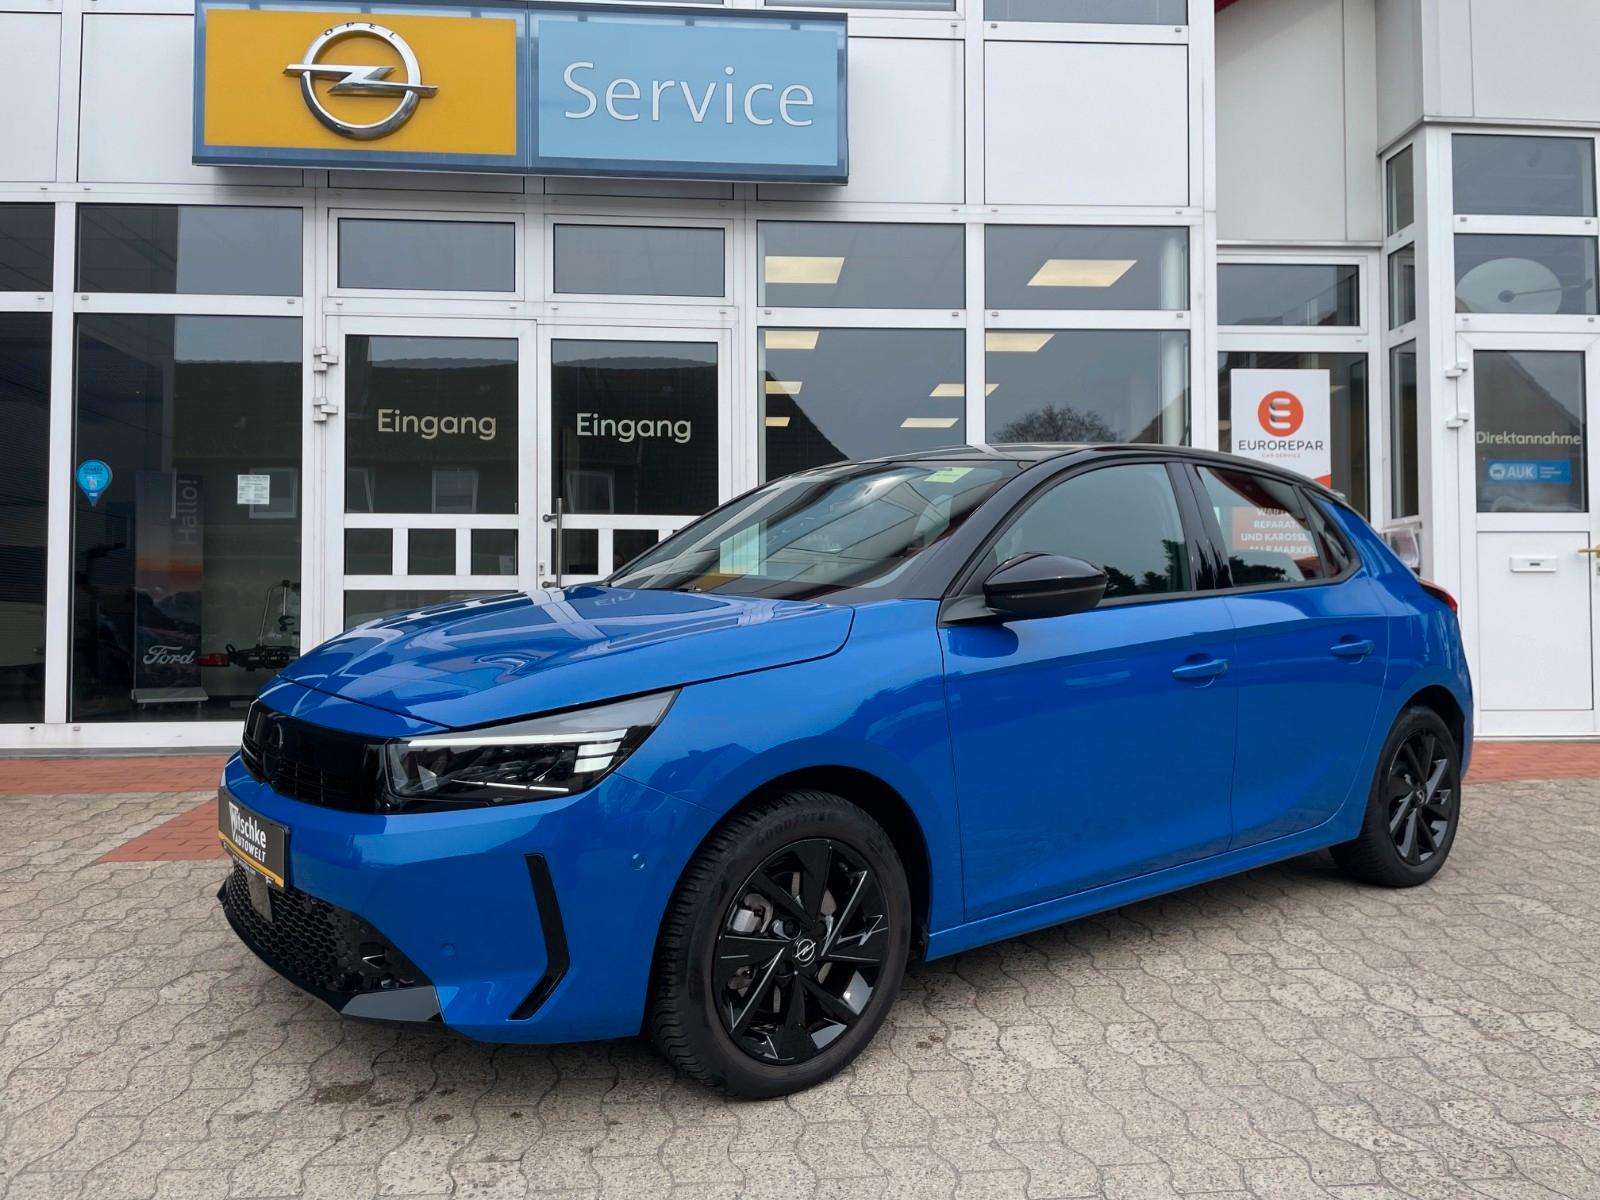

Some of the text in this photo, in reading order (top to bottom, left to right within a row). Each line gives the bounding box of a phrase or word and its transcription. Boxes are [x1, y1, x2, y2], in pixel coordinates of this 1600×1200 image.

[323, 21, 396, 39] OPEL
[562, 61, 815, 127] Service
[377, 408, 497, 441] Eingang
[576, 412, 692, 443] Eingang
[1238, 440, 1324, 451] EUROREPAR
[1476, 430, 1582, 446] Direktannahme
[1506, 465, 1535, 478] AUK
[177, 479, 198, 545] Hallo!
[1240, 532, 1263, 542] UND
[142, 645, 195, 664] Ford
